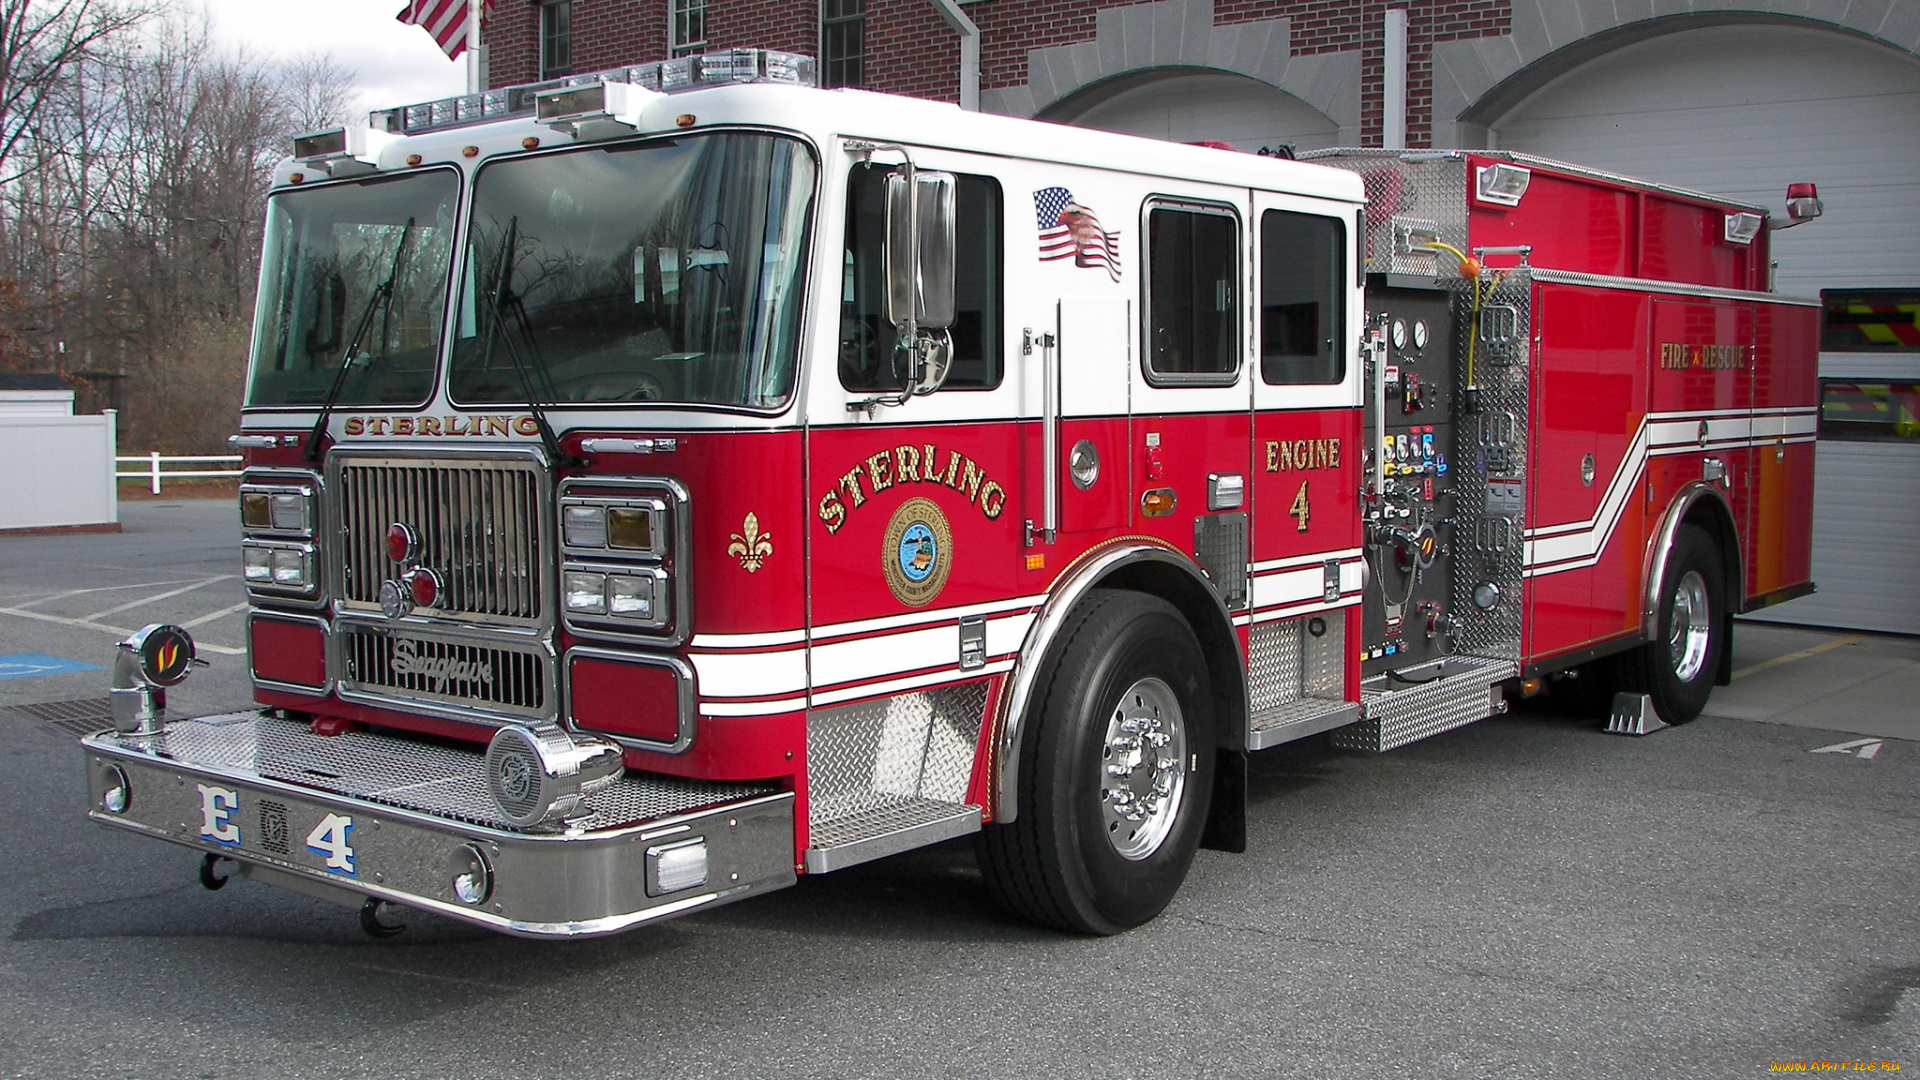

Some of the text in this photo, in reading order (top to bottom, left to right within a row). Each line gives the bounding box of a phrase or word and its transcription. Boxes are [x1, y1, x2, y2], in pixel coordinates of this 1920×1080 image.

[1661, 342, 1745, 369] FIRE RESCUE
[345, 415, 540, 438] STERLING
[1266, 438, 1341, 473] ENGINE
[818, 443, 1007, 535] STERLING
[1289, 479, 1310, 531] 4
[890, 516, 906, 553] TOWN
[906, 508, 917, 521] OF
[919, 507, 947, 549] STERLING
[391, 640, 494, 693] Seagrave
[197, 783, 357, 877] E 4
